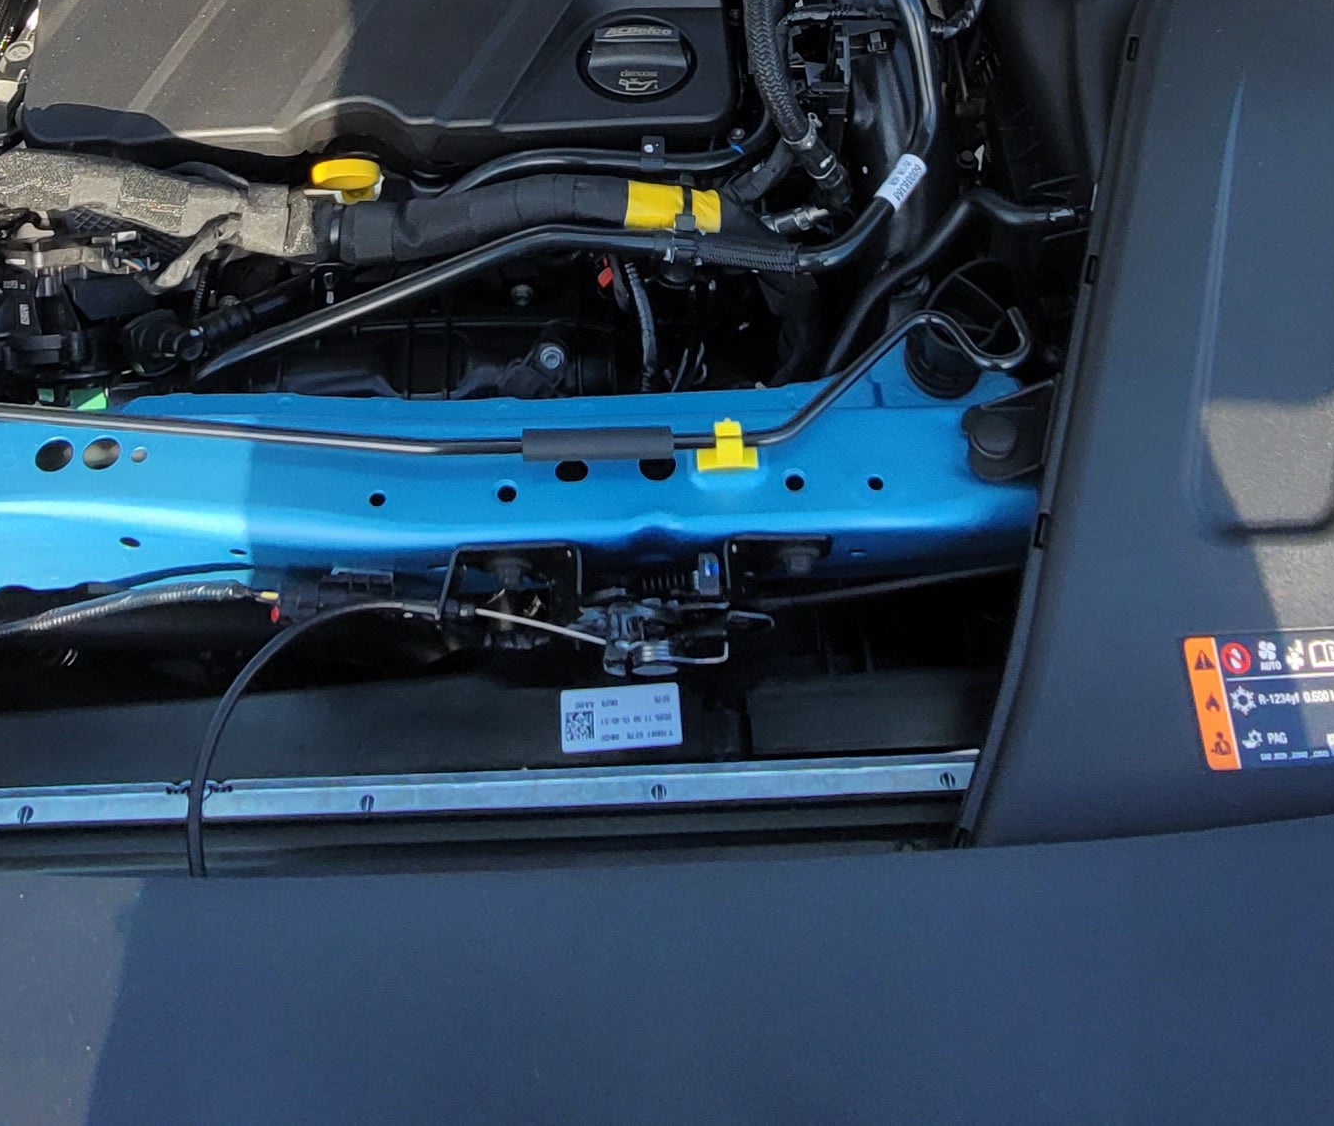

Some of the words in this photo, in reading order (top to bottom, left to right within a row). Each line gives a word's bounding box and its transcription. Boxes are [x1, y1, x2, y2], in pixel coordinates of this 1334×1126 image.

[603, 25, 673, 38] ACDelco
[1260, 660, 1282, 671] AUTO
[1303, 690, 1329, 704] 0.600
[1267, 731, 1288, 744] PAG
